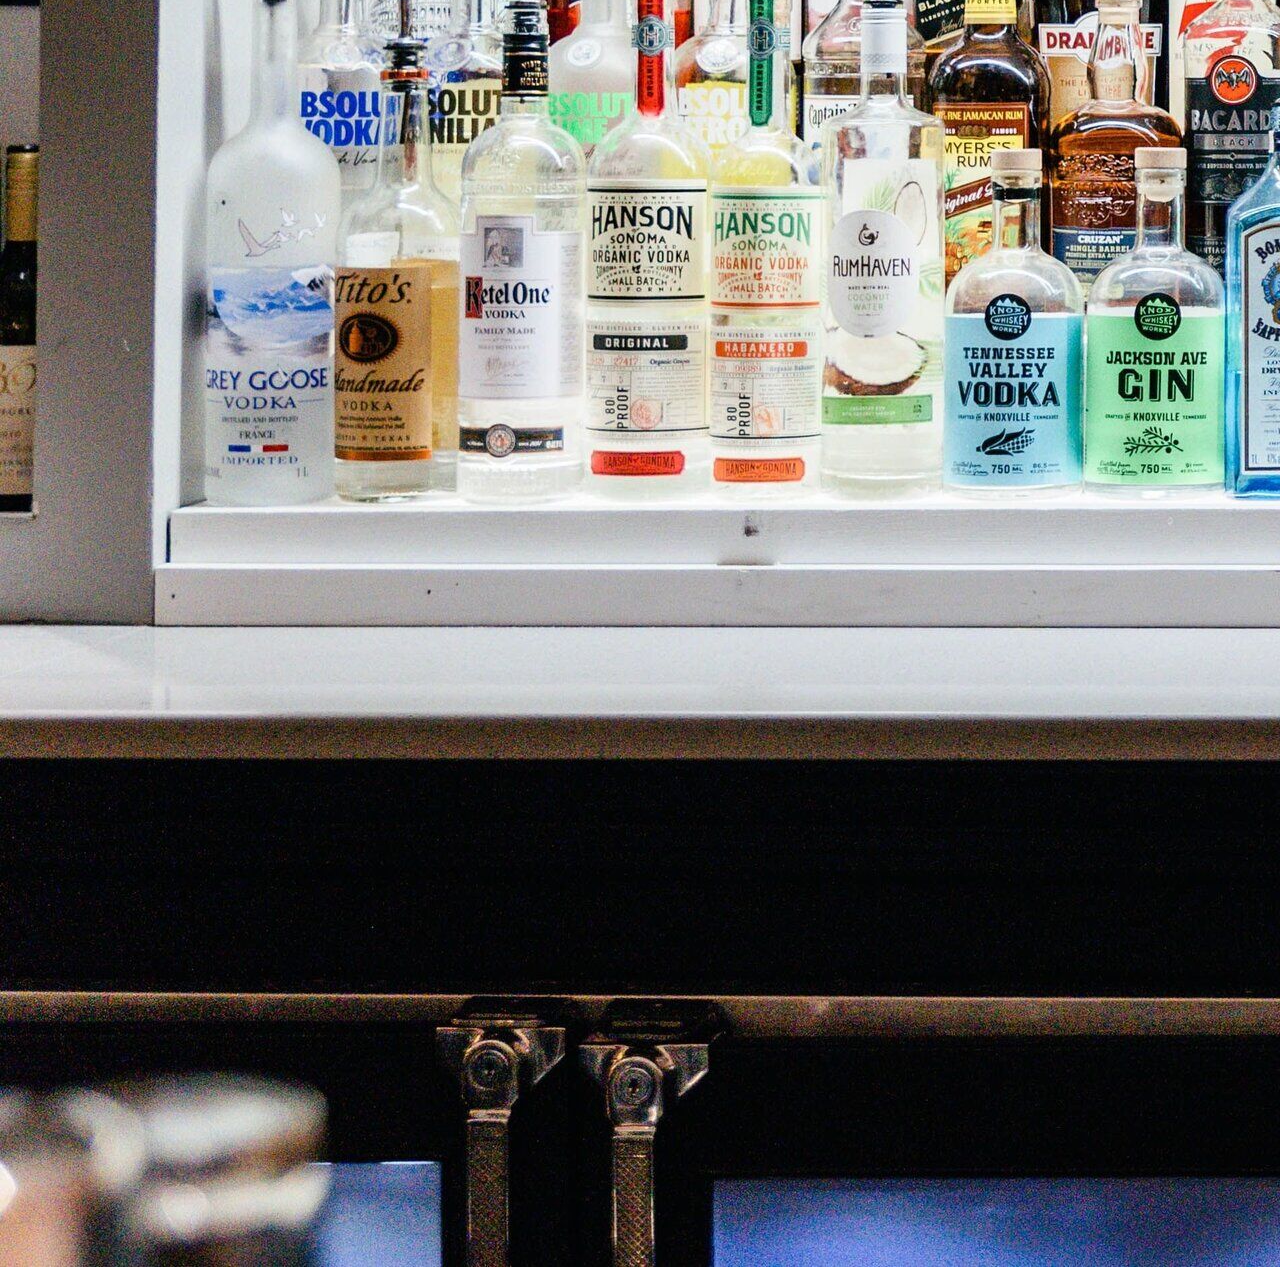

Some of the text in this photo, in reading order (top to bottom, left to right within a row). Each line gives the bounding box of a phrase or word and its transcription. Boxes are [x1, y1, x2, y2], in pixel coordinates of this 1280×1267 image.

[1004, 111, 1023, 120] RUM
[1190, 108, 1271, 132] BACARD
[957, 156, 991, 168] RUM
[592, 205, 693, 240] HANSON
[714, 212, 811, 246] HANSON
[610, 232, 667, 245] SONOMA
[1077, 234, 1121, 245] CRUZAN
[731, 240, 788, 252] SONOMA
[592, 249, 691, 264] ORGANIC VODKA
[714, 256, 809, 271] ORGANIC VODKA
[607, 274, 668, 286] SMALL BATCH
[730, 283, 757, 293] SMALL
[466, 278, 550, 316] Ketel One
[847, 293, 890, 302] COCONUT
[853, 303, 884, 312] WATER
[989, 305, 1021, 315] KNOX
[1139, 305, 1171, 315] KNOX
[485, 309, 526, 320] VODKA
[994, 315, 1028, 327] WHISKEY
[1143, 315, 1178, 327] WHISKEY
[604, 336, 670, 349] ORIGINAL
[724, 342, 795, 353] HABANERO
[963, 346, 1056, 360] TENNESSEE
[1106, 350, 1208, 366] JACKSON AVE
[969, 362, 1048, 378] VALLEY
[249, 366, 328, 391] GOOSE
[1117, 367, 1195, 403] GIN
[957, 380, 1061, 408] VODKA
[224, 396, 297, 410] VODKA
[343, 400, 393, 412] VODKA
[616, 386, 629, 429] PROOF
[726, 405, 738, 422] 80
[738, 392, 751, 436] PROOF
[983, 412, 1031, 422] KNOXVILLE
[1133, 412, 1180, 422] KNOXVILLE
[239, 430, 275, 441] FRANCE
[221, 456, 299, 466] IMPORTED
[991, 464, 1011, 475] 750
[1140, 464, 1160, 475] 750
